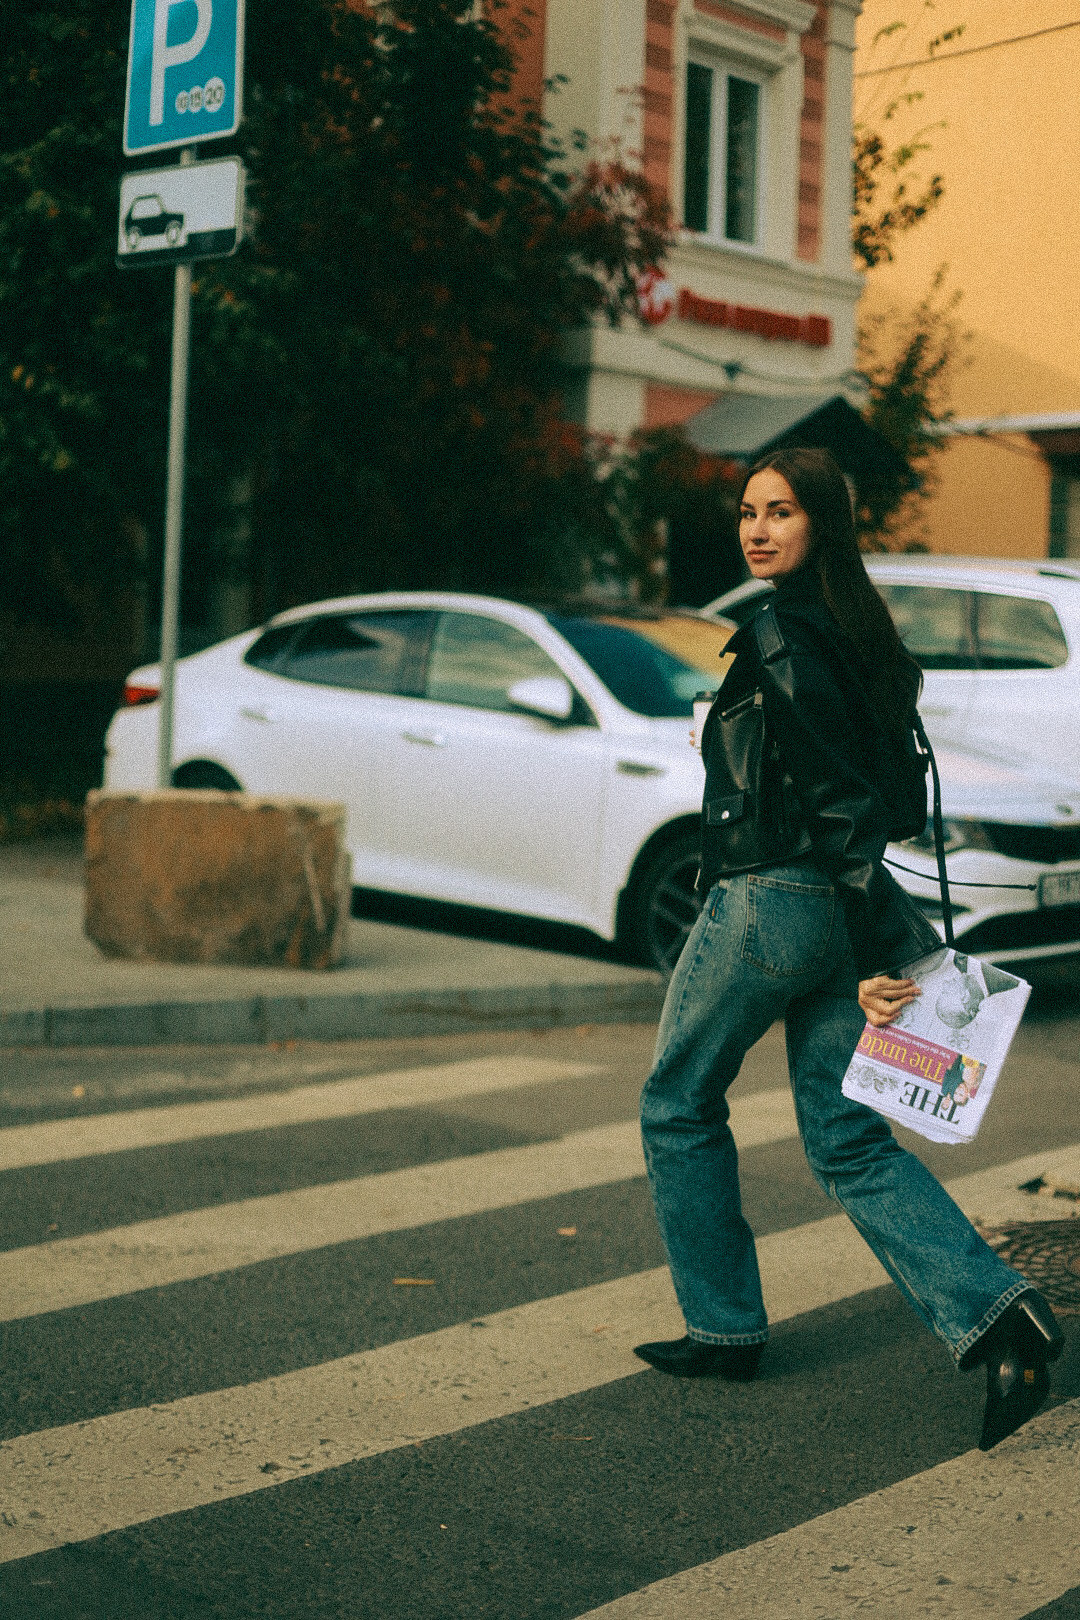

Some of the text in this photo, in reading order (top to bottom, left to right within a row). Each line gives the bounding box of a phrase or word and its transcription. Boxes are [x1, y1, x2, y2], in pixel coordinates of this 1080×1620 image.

[149, 0, 213, 126] P
[205, 85, 224, 106] 20
[909, 1052, 945, 1083] The
[899, 1081, 960, 1125] THE
